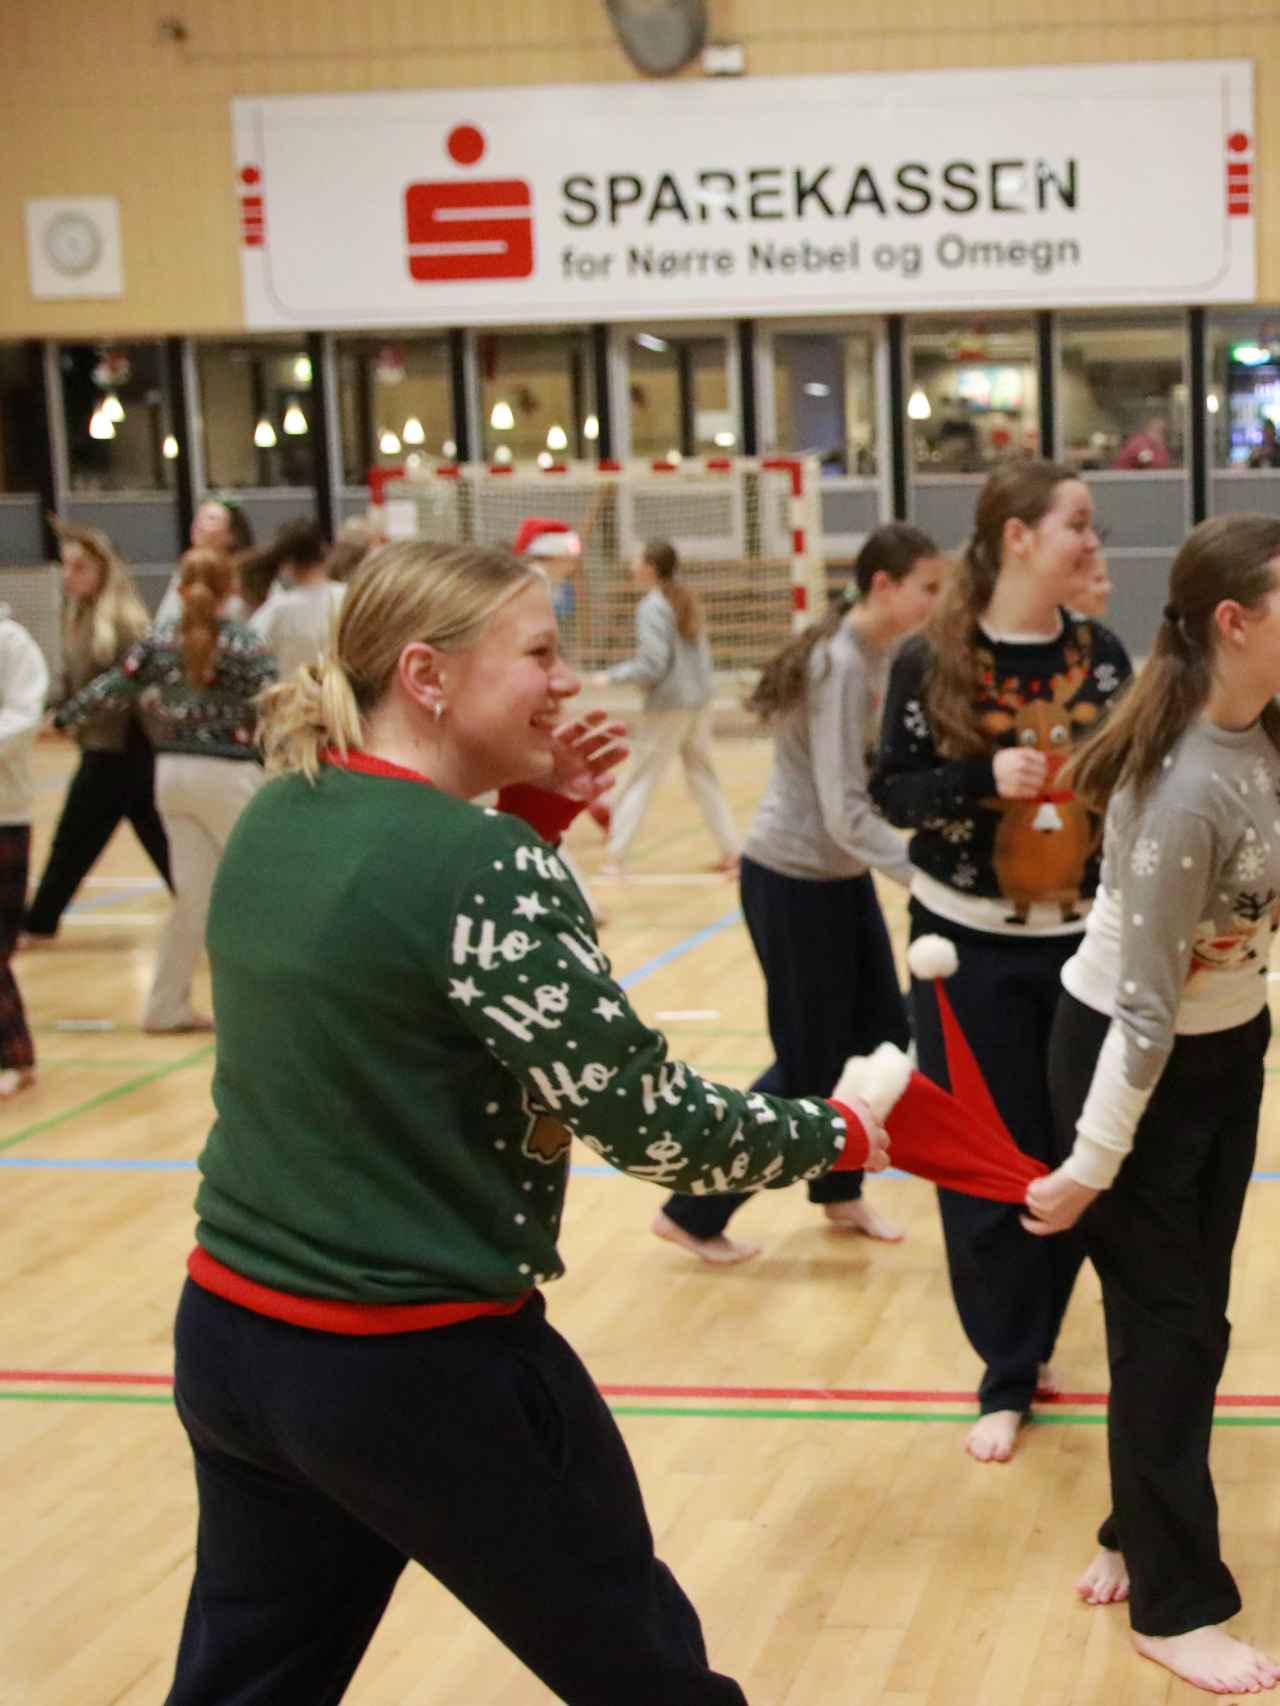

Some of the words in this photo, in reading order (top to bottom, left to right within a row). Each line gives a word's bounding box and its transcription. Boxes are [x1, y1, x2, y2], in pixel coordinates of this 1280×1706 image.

[561, 158, 1078, 227] SPAREKASSEN
[562, 247, 612, 278] for
[627, 246, 734, 277] Nørre
[750, 240, 860, 274] Nebel
[872, 243, 922, 279] og
[936, 232, 1081, 276] Omegn
[453, 914, 541, 971] Ho
[482, 982, 569, 1042] Ho
[528, 1061, 619, 1109] Ho
